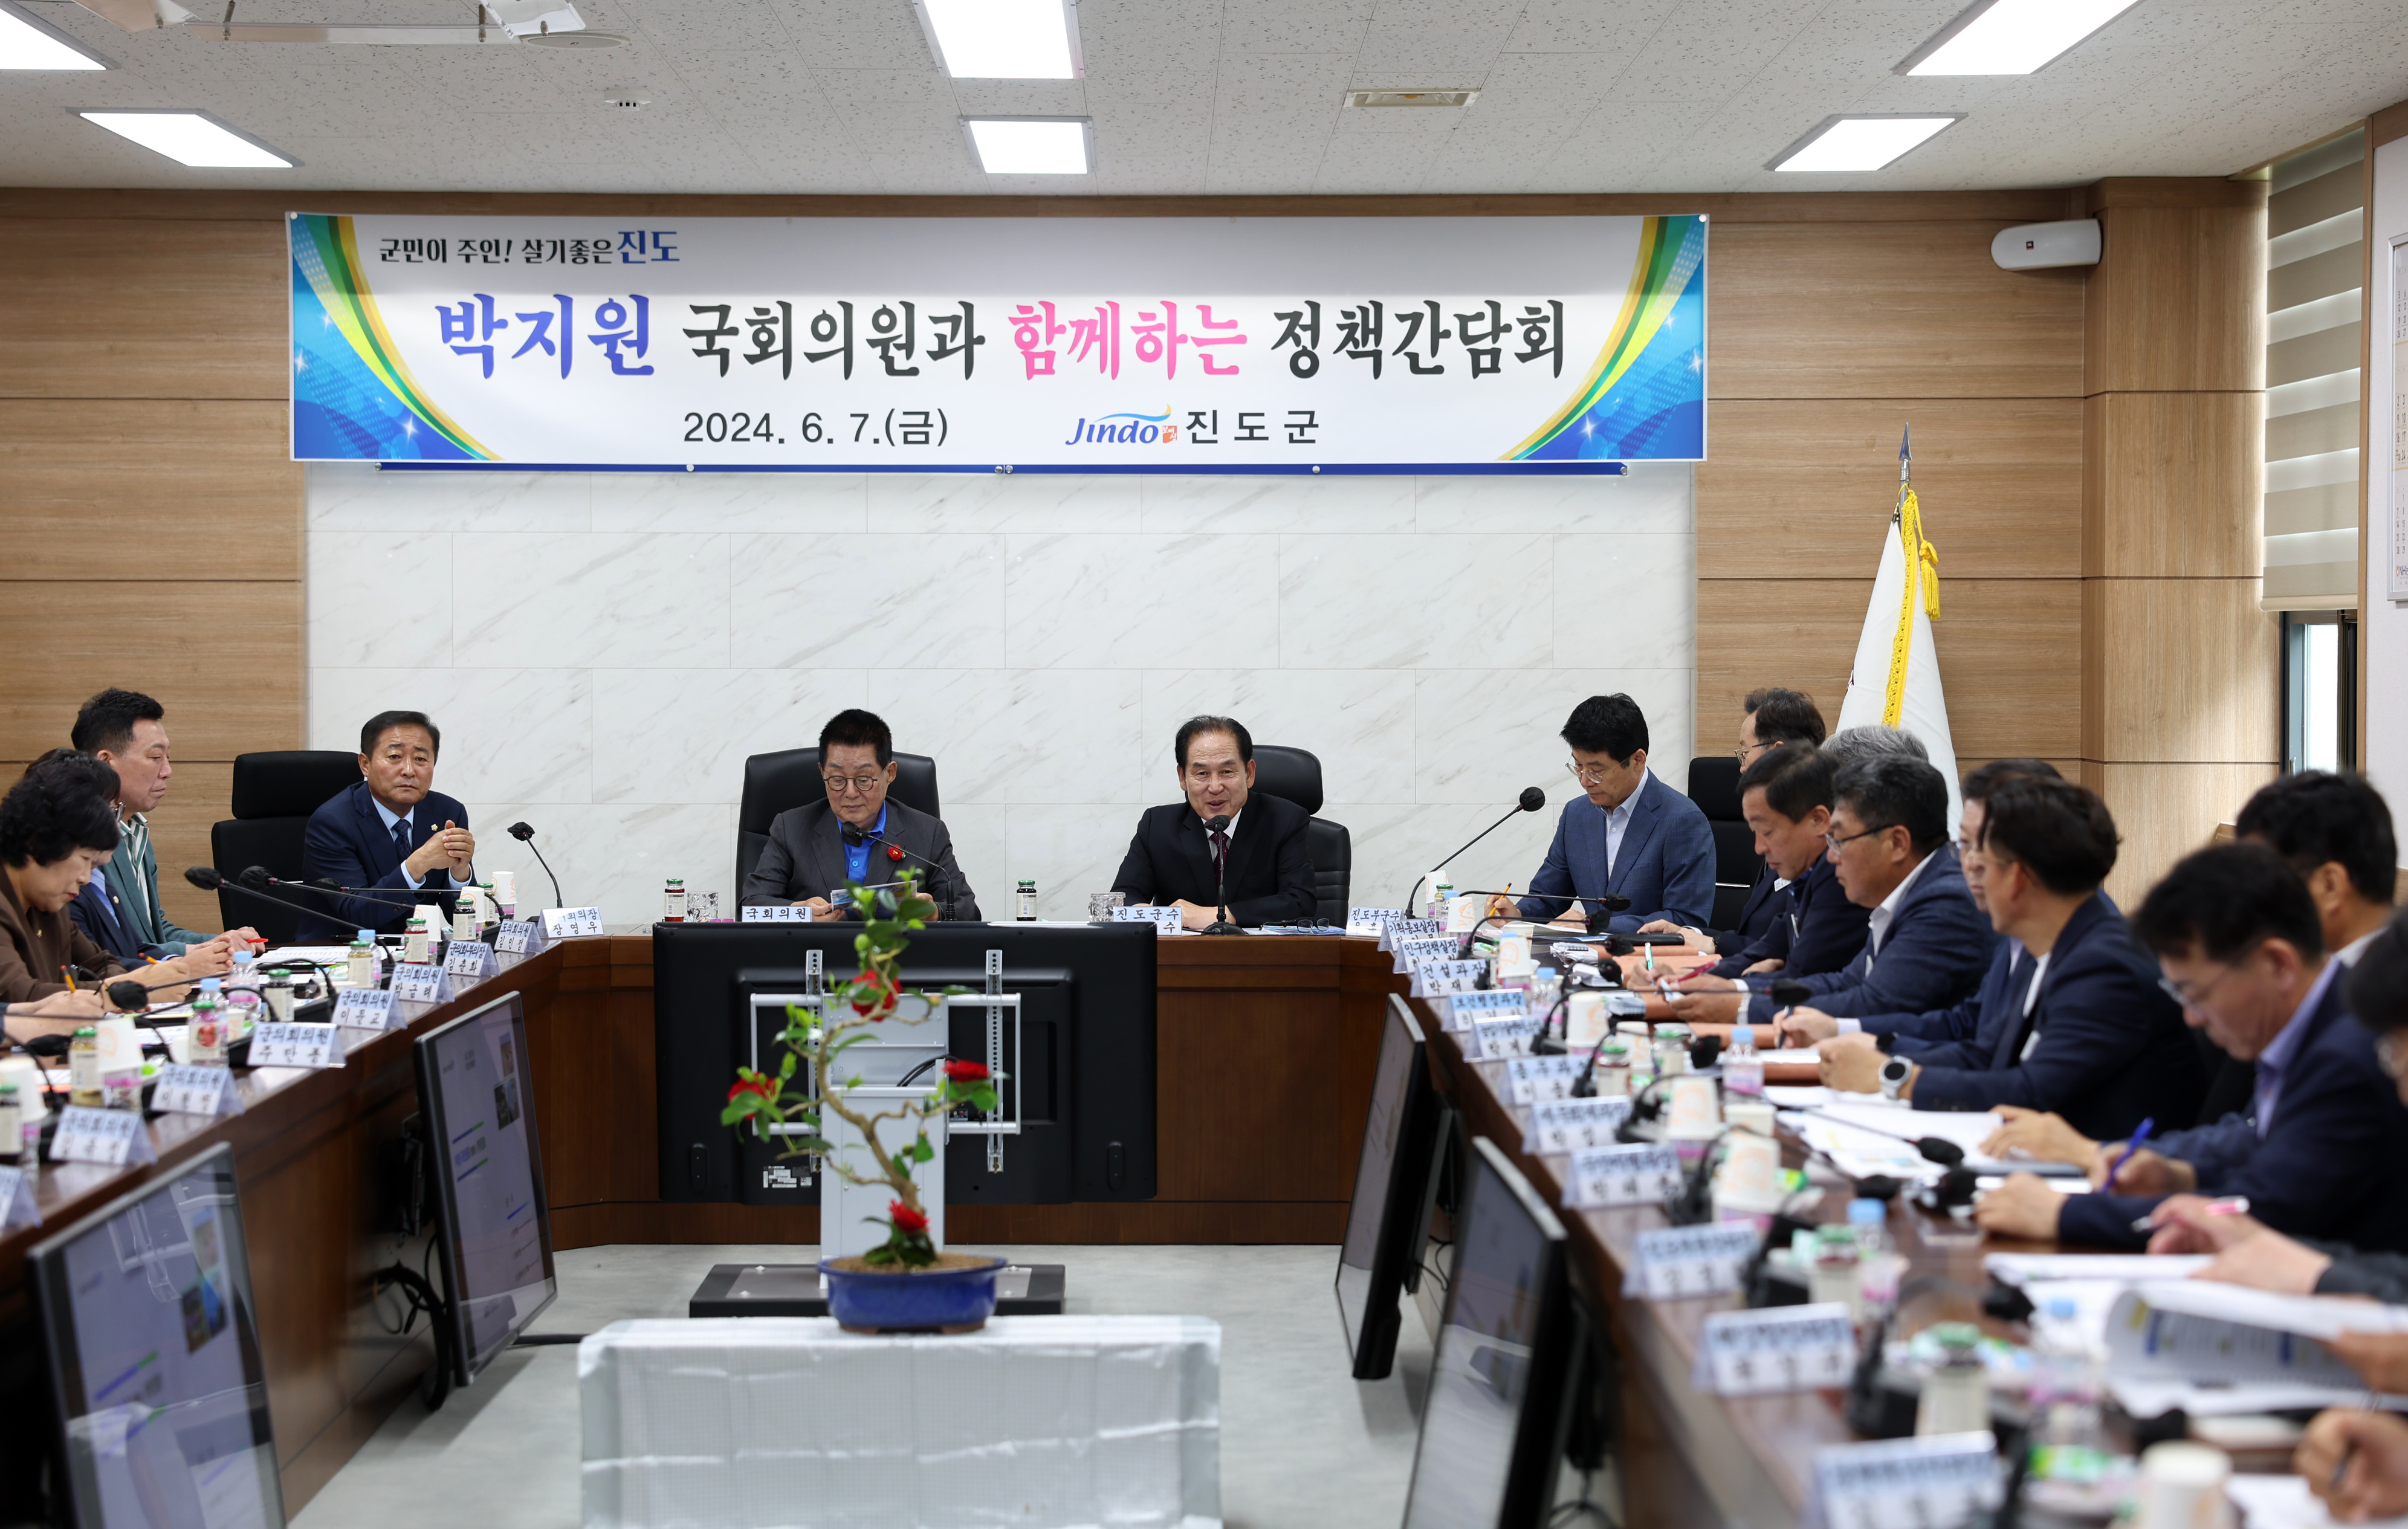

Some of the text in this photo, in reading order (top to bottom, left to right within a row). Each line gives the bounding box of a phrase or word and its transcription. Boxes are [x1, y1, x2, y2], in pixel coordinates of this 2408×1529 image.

[380, 239, 447, 263] 군민이
[457, 239, 513, 263] 주인!
[435, 293, 1564, 381] 박지원 국회의원과 함께하는 정책간담회
[684, 412, 785, 444] 2024.
[801, 412, 834, 444] 6.
[1065, 418, 1159, 445] Jindo
[1351, 908, 1399, 922] 진도부군수
[500, 922, 531, 937] 도의회의원
[1389, 919, 1435, 935] 기획홍보실장
[450, 943, 486, 959] 군의회부의장
[1404, 939, 1458, 956] 인구정책실장
